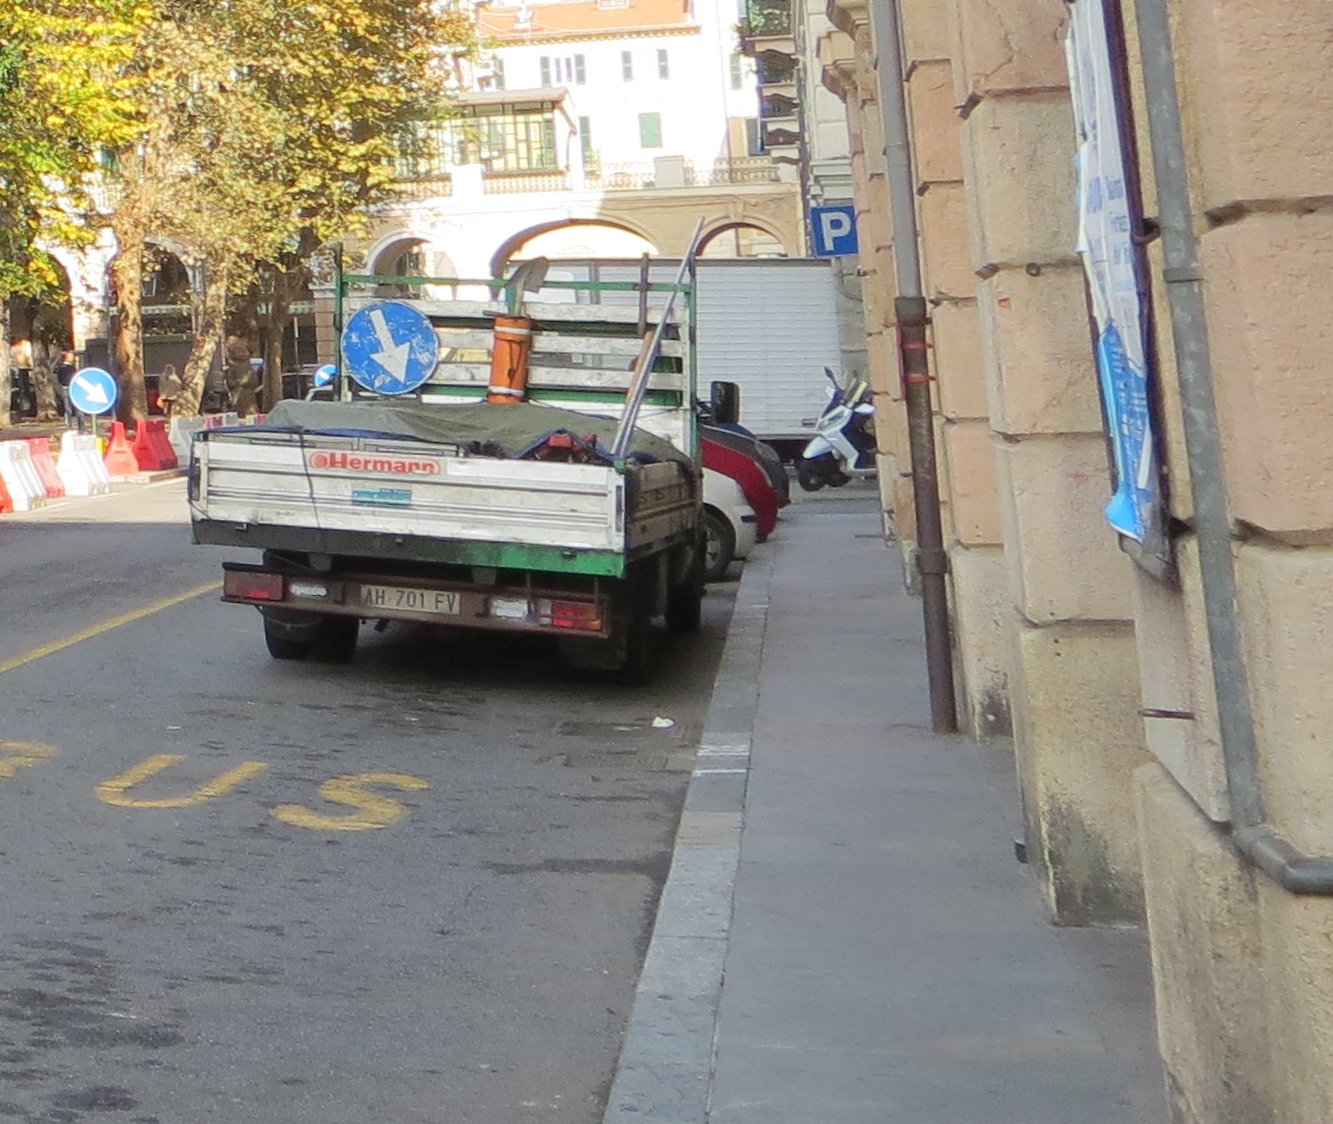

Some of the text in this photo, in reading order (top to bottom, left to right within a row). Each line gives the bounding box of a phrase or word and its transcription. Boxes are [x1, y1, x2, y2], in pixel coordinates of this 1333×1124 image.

[819, 211, 852, 252] P
[329, 452, 435, 474] Hermann
[365, 587, 457, 613] AH 701 FV
